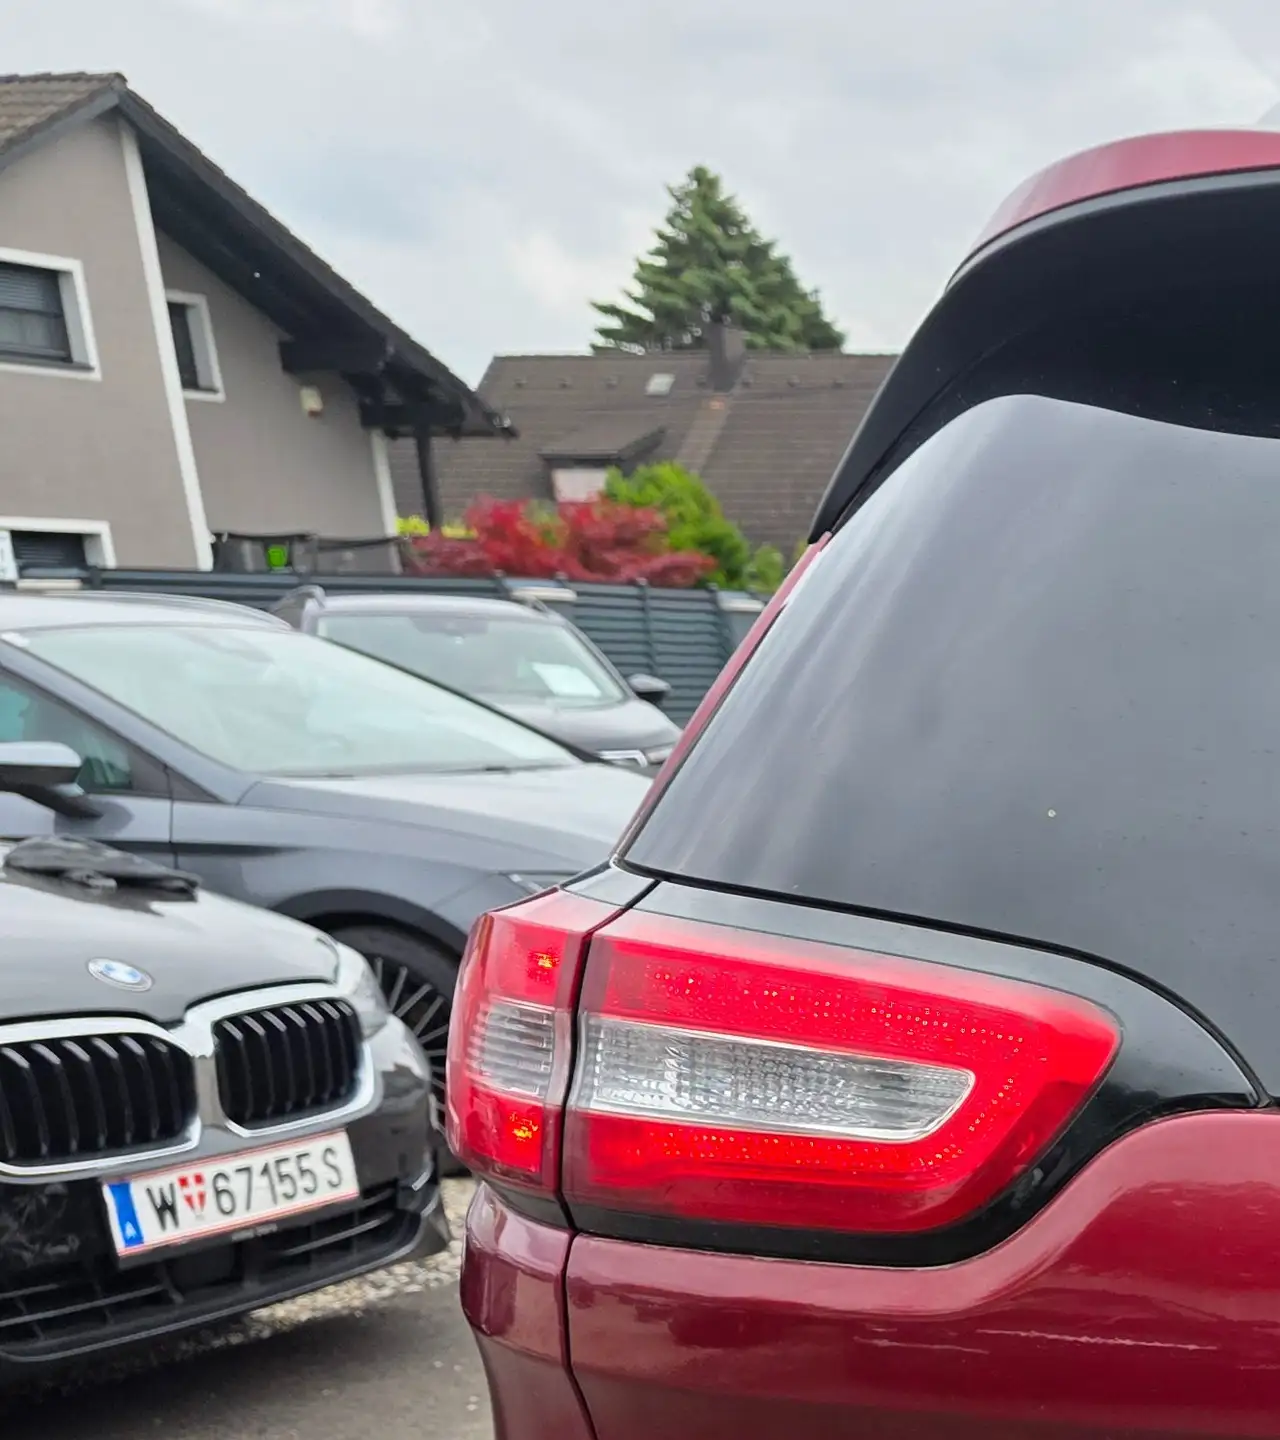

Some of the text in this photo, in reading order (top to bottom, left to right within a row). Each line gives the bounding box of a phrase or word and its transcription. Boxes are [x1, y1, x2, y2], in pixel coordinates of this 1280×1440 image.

[145, 1182, 180, 1232] W
[211, 1151, 319, 1216] 67155
[324, 1146, 344, 1190] S
